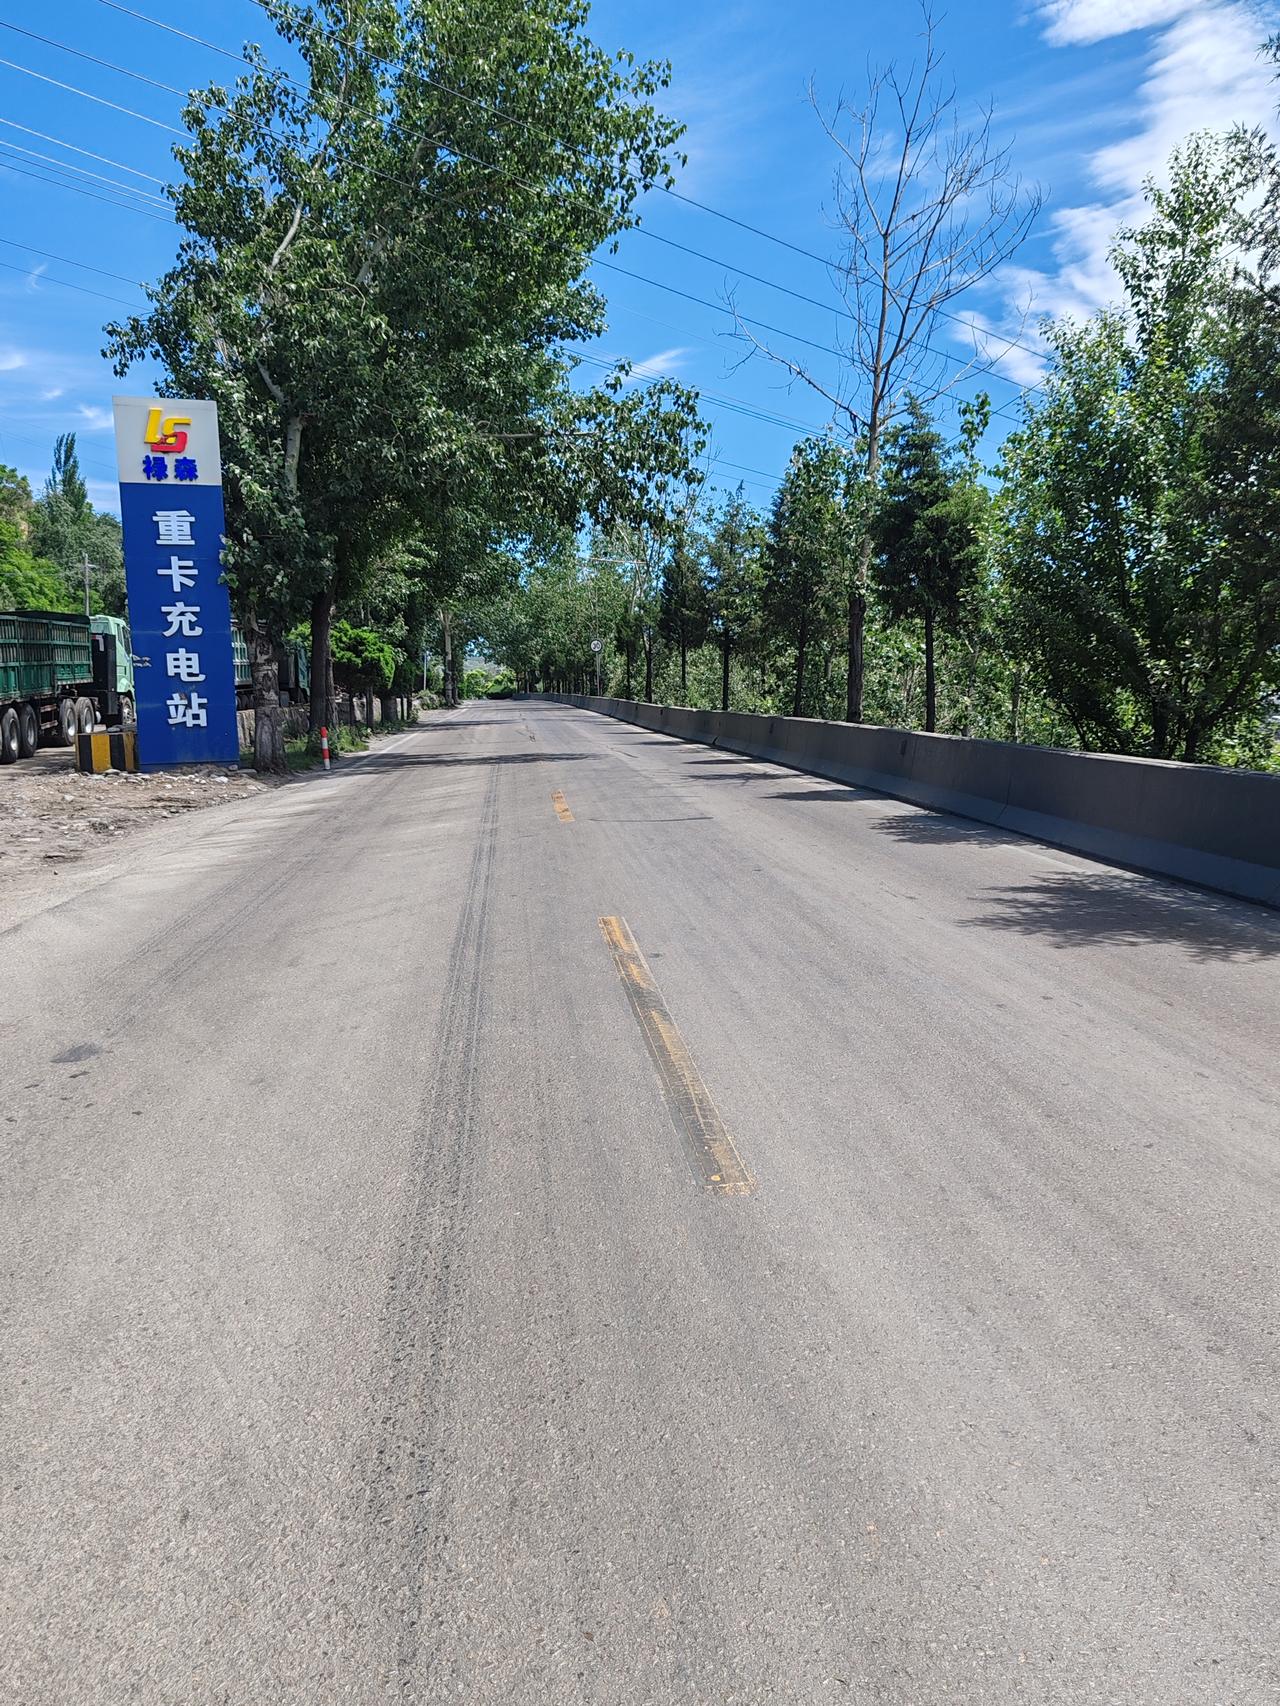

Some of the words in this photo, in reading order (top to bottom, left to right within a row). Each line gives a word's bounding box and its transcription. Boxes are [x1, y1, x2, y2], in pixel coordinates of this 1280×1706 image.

[152, 510, 208, 728] 重卡充电站
